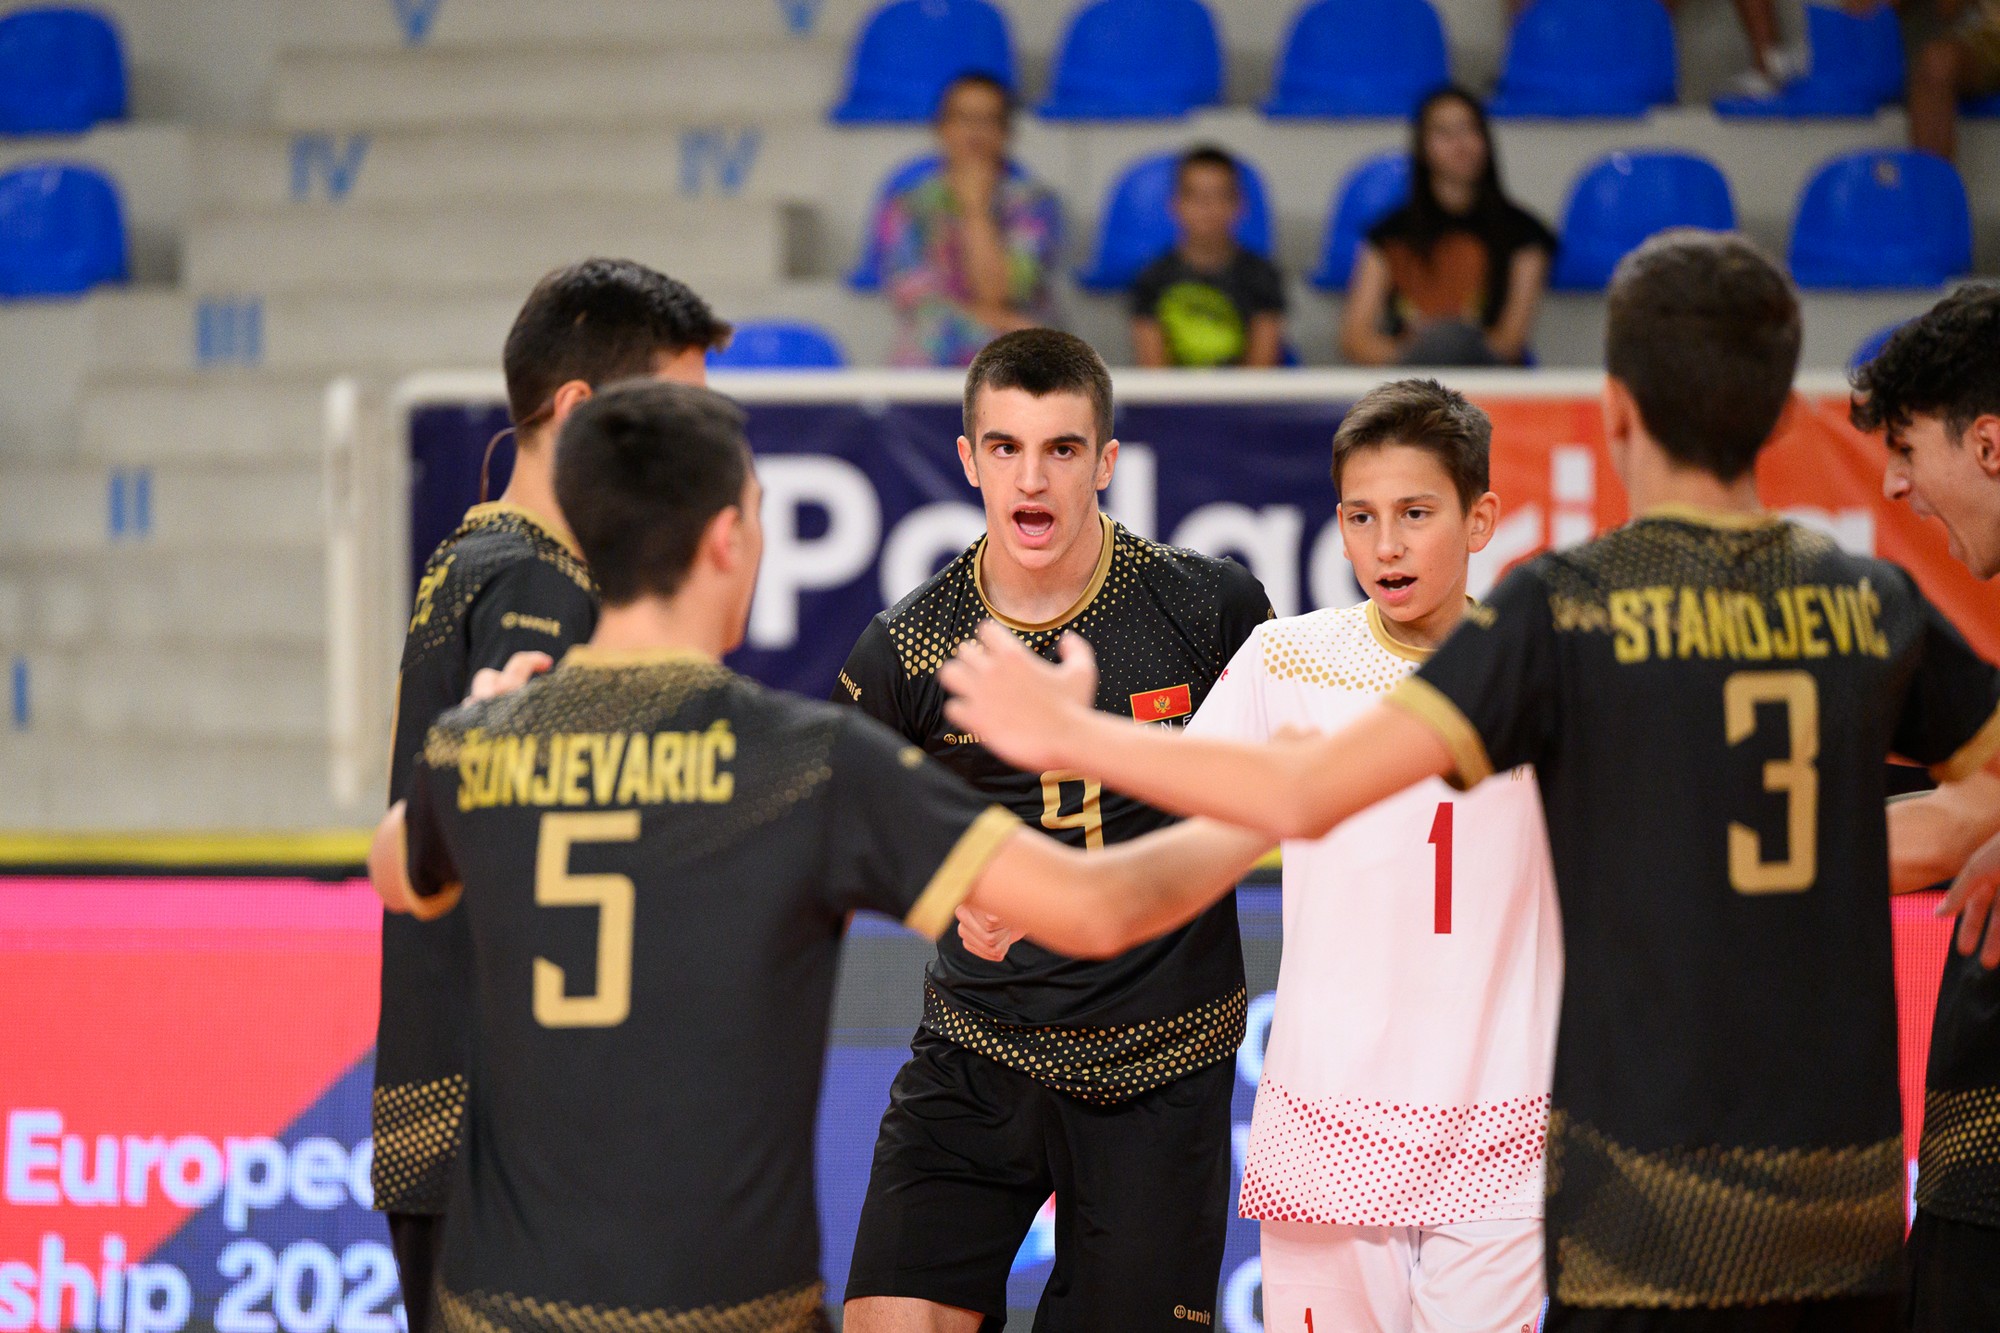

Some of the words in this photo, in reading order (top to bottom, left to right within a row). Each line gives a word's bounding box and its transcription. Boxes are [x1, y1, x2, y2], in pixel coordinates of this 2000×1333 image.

[291, 131, 371, 203] IV
[678, 126, 763, 199] IV
[109, 466, 152, 537] II
[840, 672, 863, 701] unit
[1040, 768, 1105, 851] 9
[1723, 670, 1820, 895] 3
[1427, 802, 1453, 934] 1
[532, 810, 641, 1027] 5
[212, 1238, 409, 1333] 202
[1187, 1308, 1211, 1326] unit
